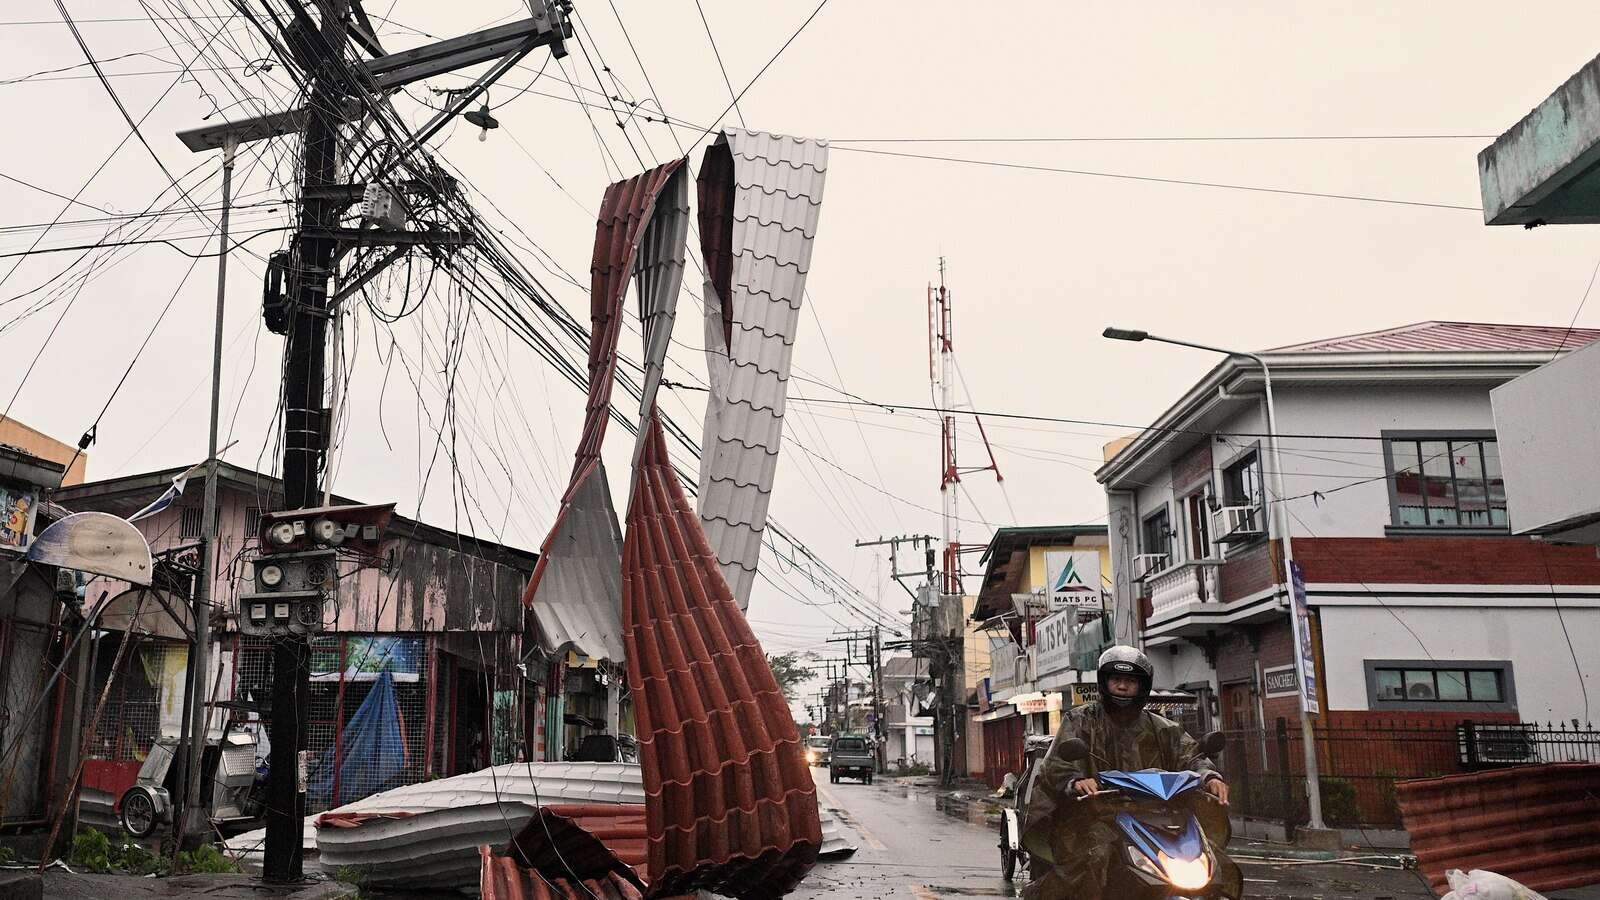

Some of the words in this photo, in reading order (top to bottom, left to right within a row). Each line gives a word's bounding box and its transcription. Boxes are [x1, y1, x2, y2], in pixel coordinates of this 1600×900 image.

[1036, 623, 1055, 654] MTS
[1056, 616, 1068, 648] PC
[1267, 673, 1295, 689] SANCHEZ
